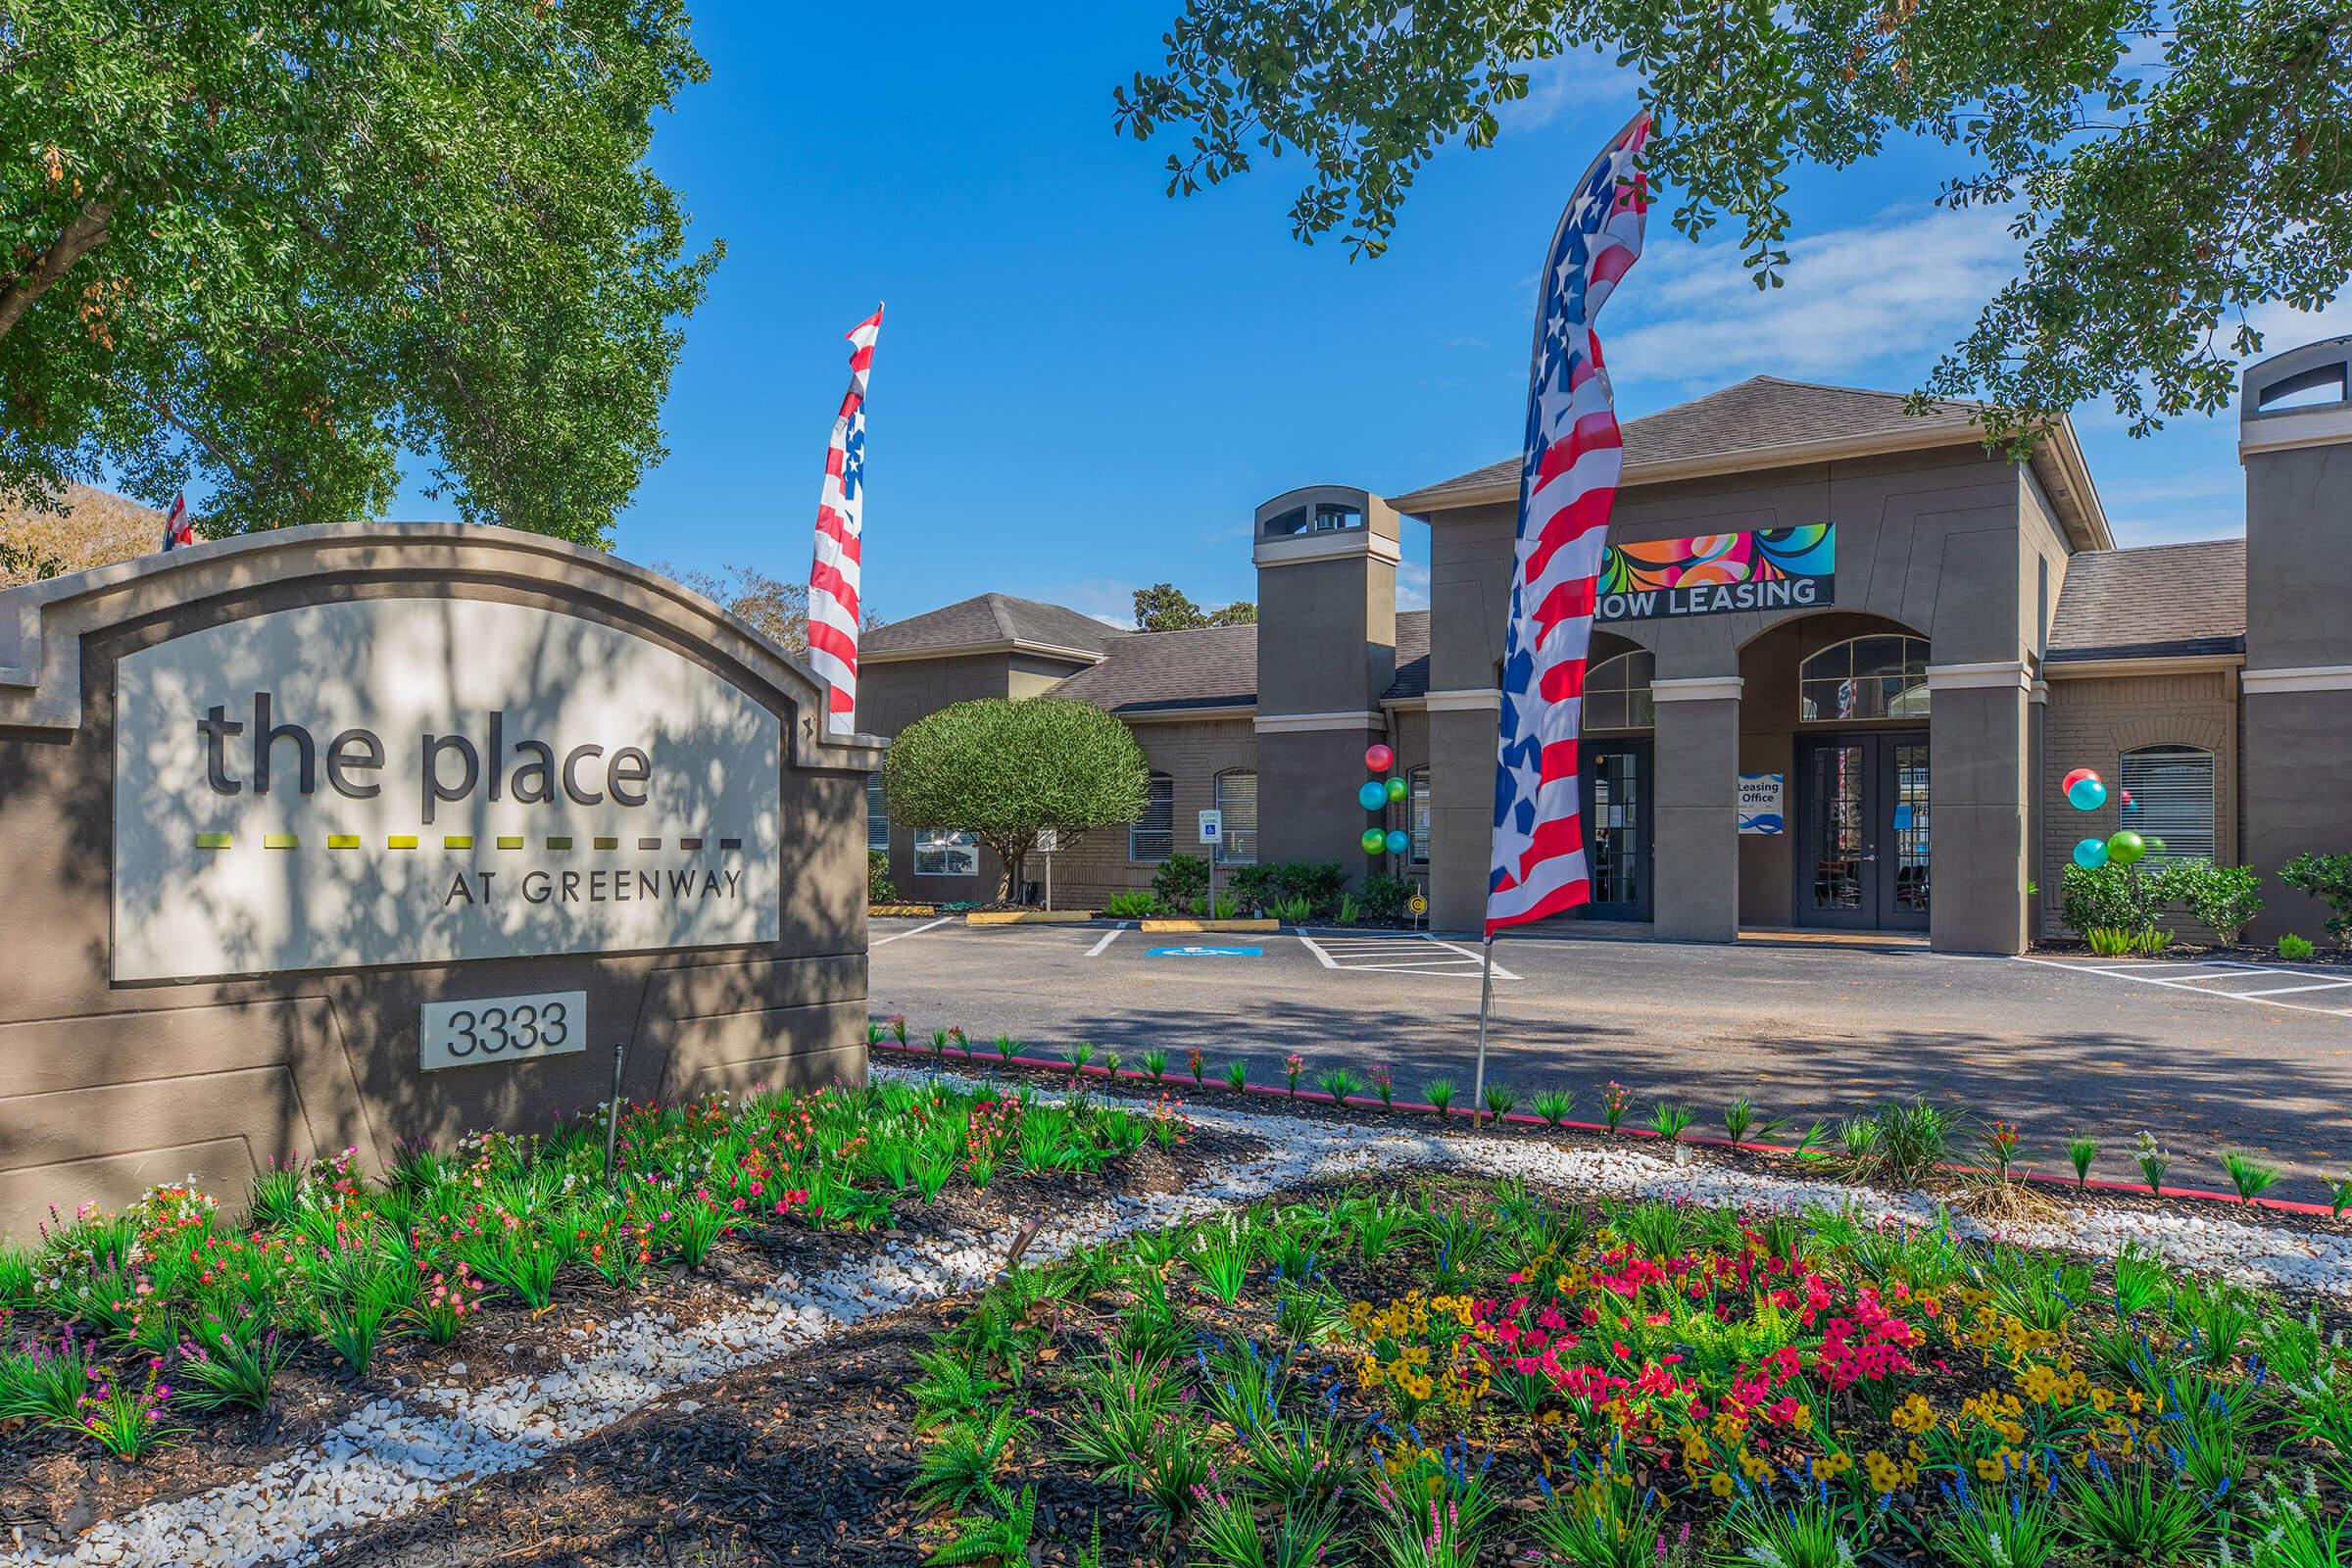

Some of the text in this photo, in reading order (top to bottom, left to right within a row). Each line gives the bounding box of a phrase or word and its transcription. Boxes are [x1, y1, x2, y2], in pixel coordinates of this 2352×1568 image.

[1669, 578, 1815, 614] LEASING
[196, 692, 652, 825] the place
[1738, 782, 1779, 793] Leasing
[1741, 793, 1774, 803] Office
[444, 869, 741, 906] AT GREENWAY
[447, 1002, 567, 1057] 3333
